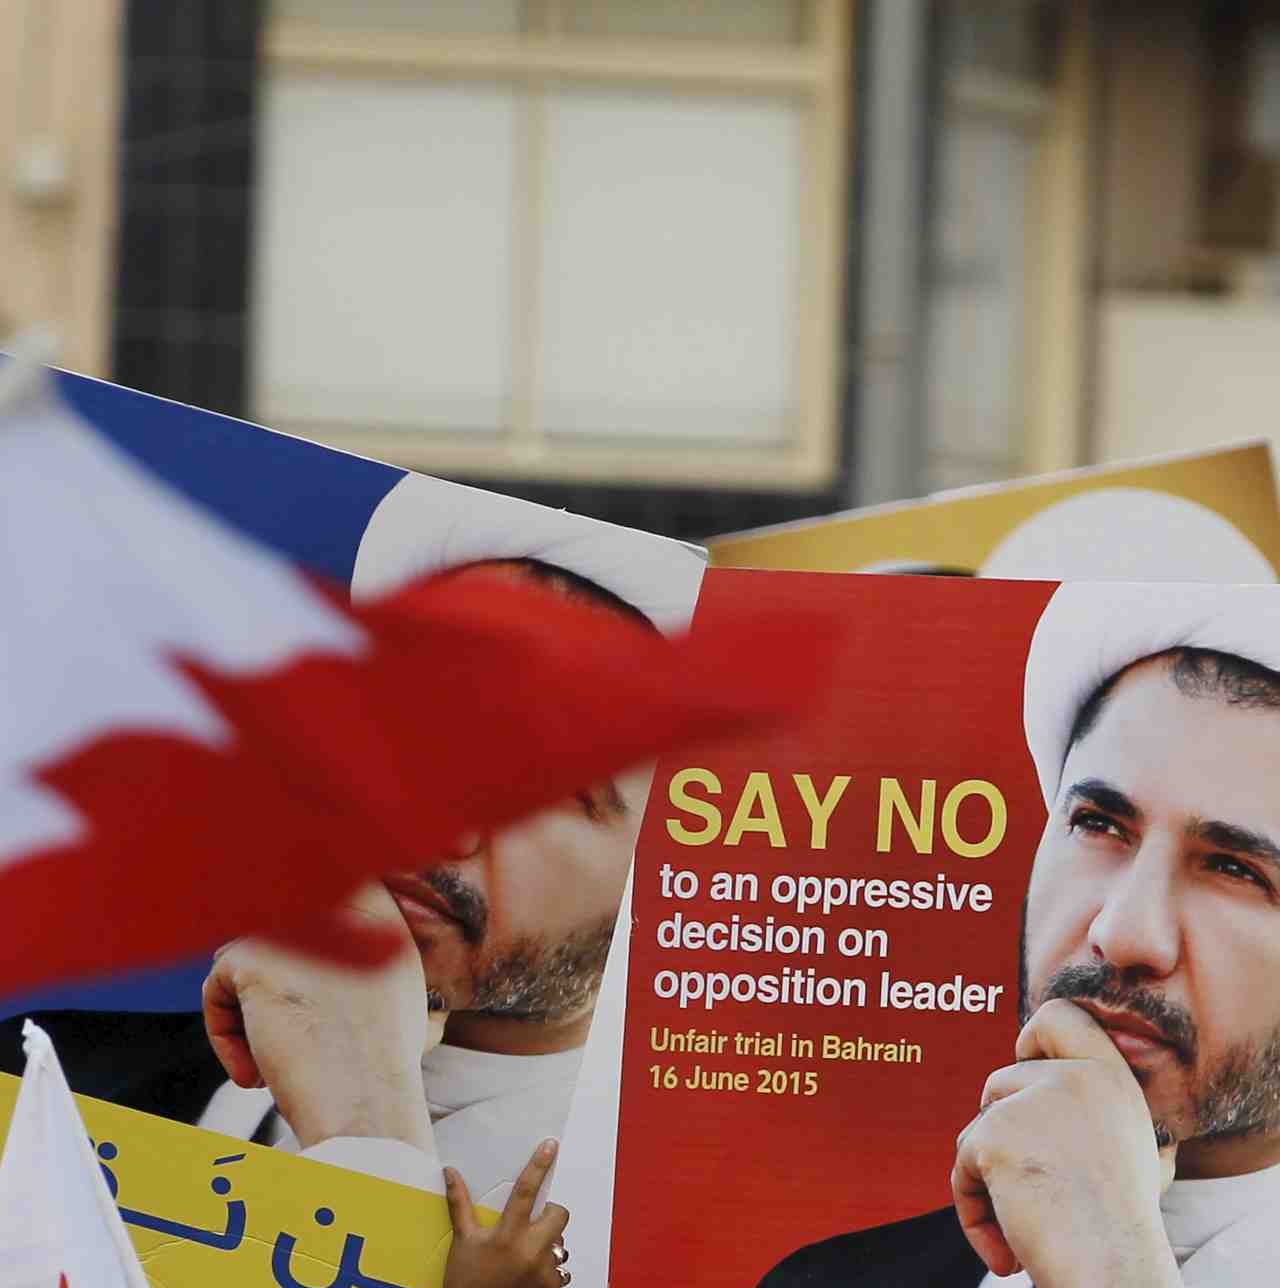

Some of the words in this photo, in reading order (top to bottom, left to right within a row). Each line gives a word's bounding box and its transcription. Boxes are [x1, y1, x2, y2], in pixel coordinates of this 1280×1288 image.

[665, 767, 852, 850] SAY
[876, 777, 1008, 858] NO
[659, 863, 699, 898] to
[710, 871, 759, 902] an
[770, 873, 994, 915] oppressive
[656, 912, 825, 955] decision
[838, 927, 889, 958] on
[653, 966, 867, 1010] opposition
[879, 972, 1004, 1013] leader
[649, 1027, 728, 1055] Unfair
[735, 1030, 784, 1057] trial
[791, 1034, 814, 1059] in
[822, 1035, 923, 1064] Bahrain
[649, 1065, 679, 1090] 16
[685, 1066, 749, 1092] June
[756, 1068, 819, 1096] 2015
